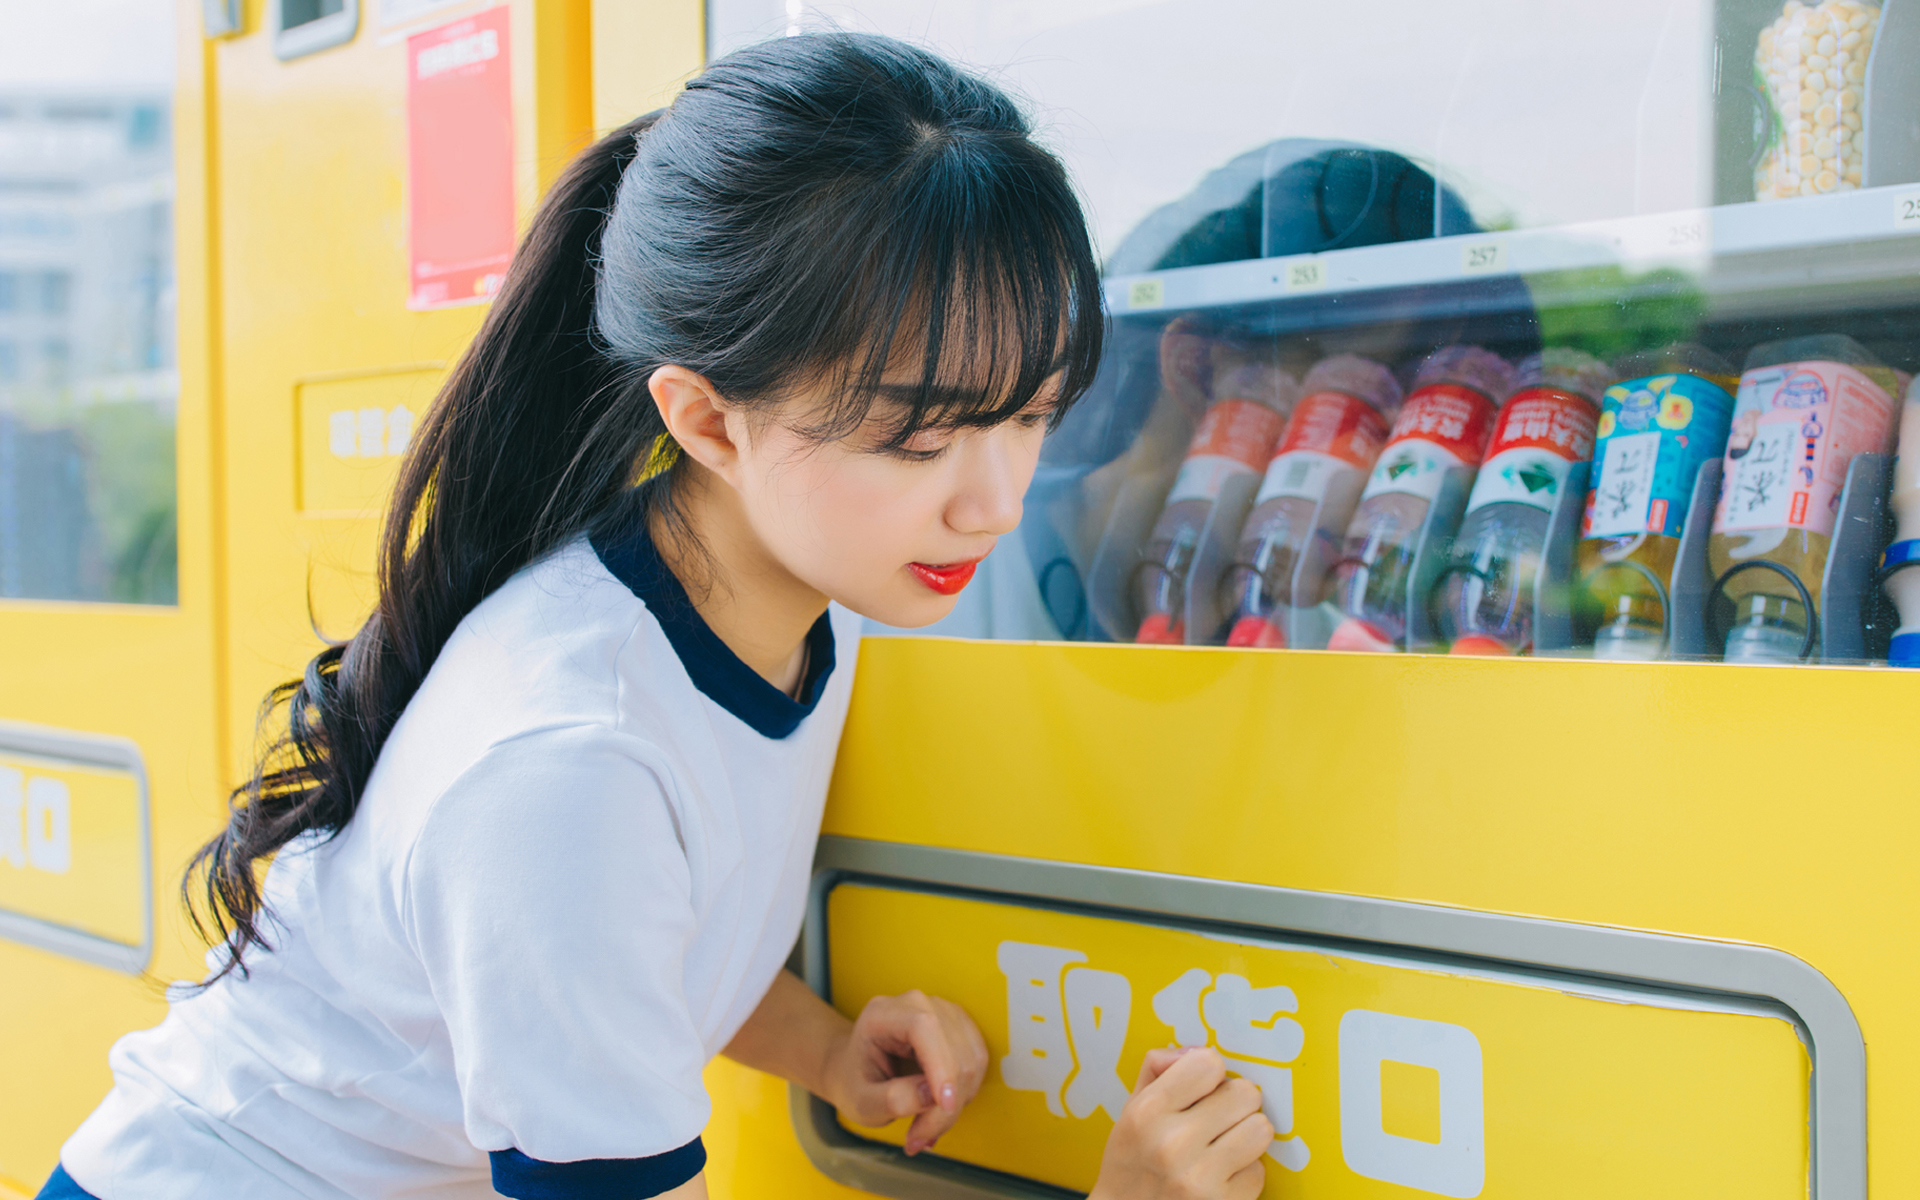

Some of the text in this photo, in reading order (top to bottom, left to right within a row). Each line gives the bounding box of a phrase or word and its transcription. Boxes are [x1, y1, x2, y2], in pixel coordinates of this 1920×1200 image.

[1468, 246, 1498, 267] 257
[997, 941, 1485, 1199] 取货口
